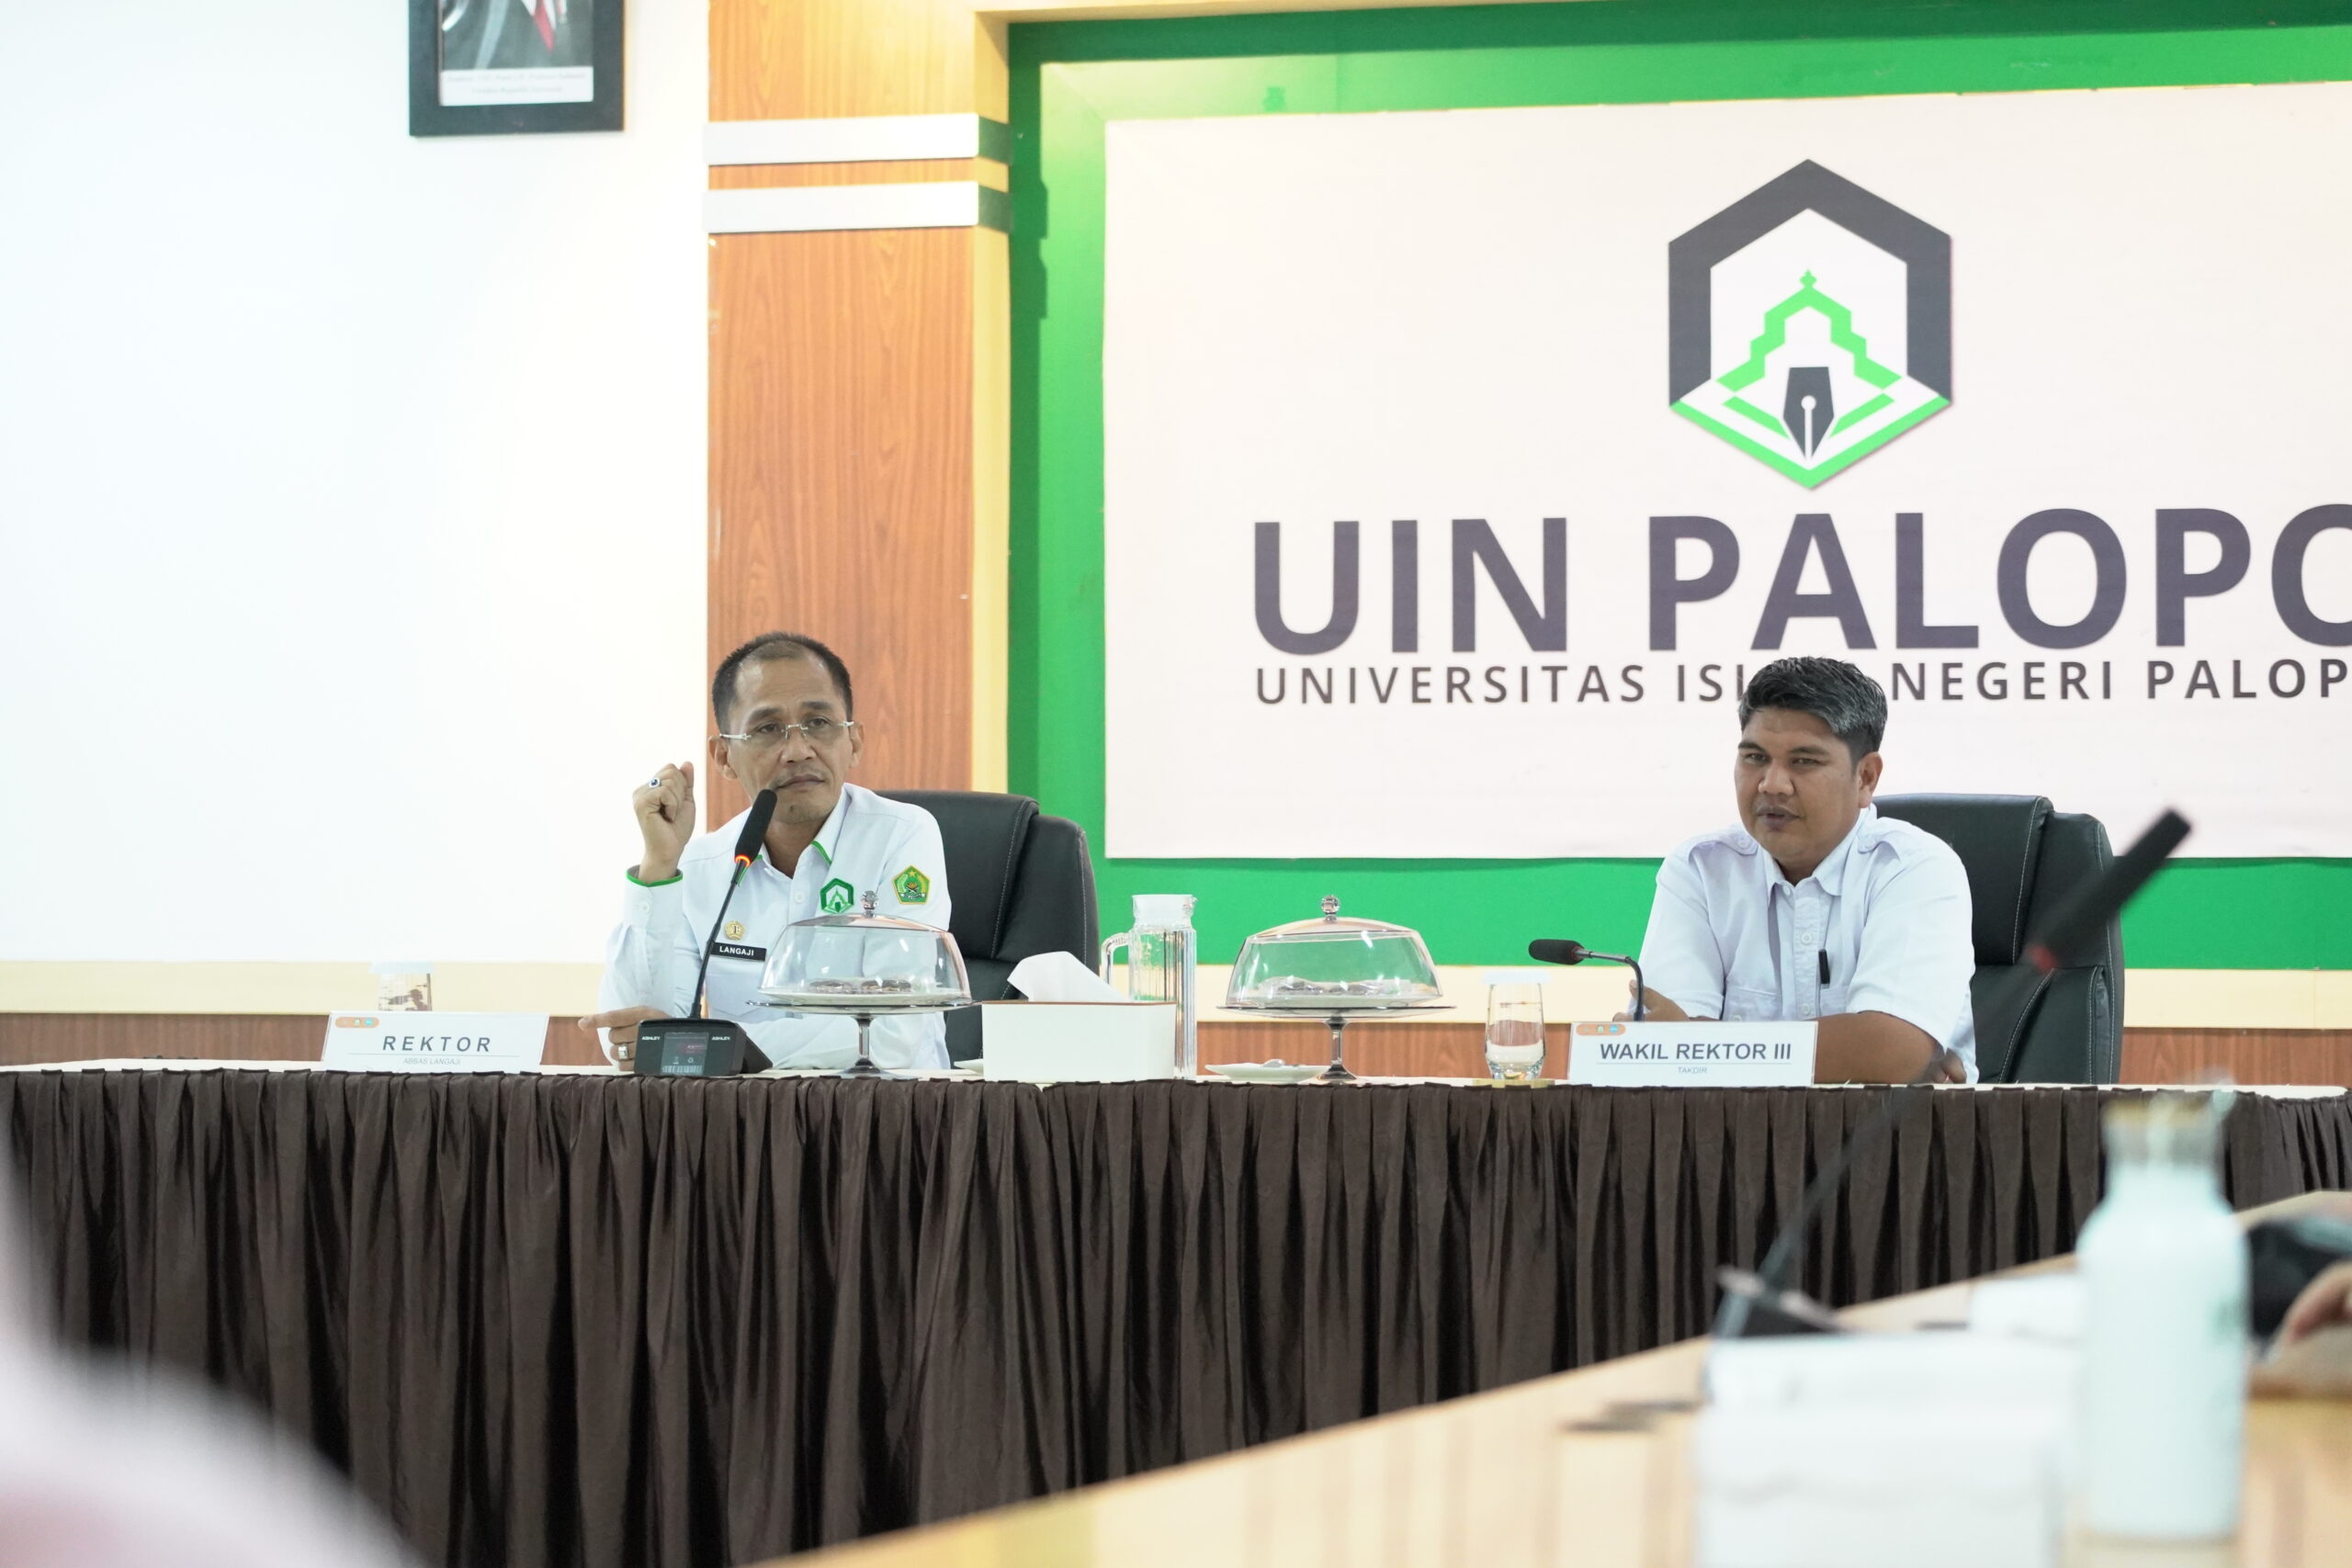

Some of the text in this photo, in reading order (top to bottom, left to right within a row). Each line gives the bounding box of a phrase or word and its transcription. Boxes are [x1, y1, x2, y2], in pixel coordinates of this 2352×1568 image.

[1254, 503, 2352, 656] UIN PALOPO
[1257, 664, 1645, 705] UNIVERSITAS
[1892, 660, 2111, 700] NEGERI
[718, 945, 755, 956] LANGAJI
[382, 1035, 491, 1053] REKTOR
[1600, 1043, 1792, 1060] WAKIL REKTOR III
[402, 1057, 461, 1066] ABBAS LANGAJI
